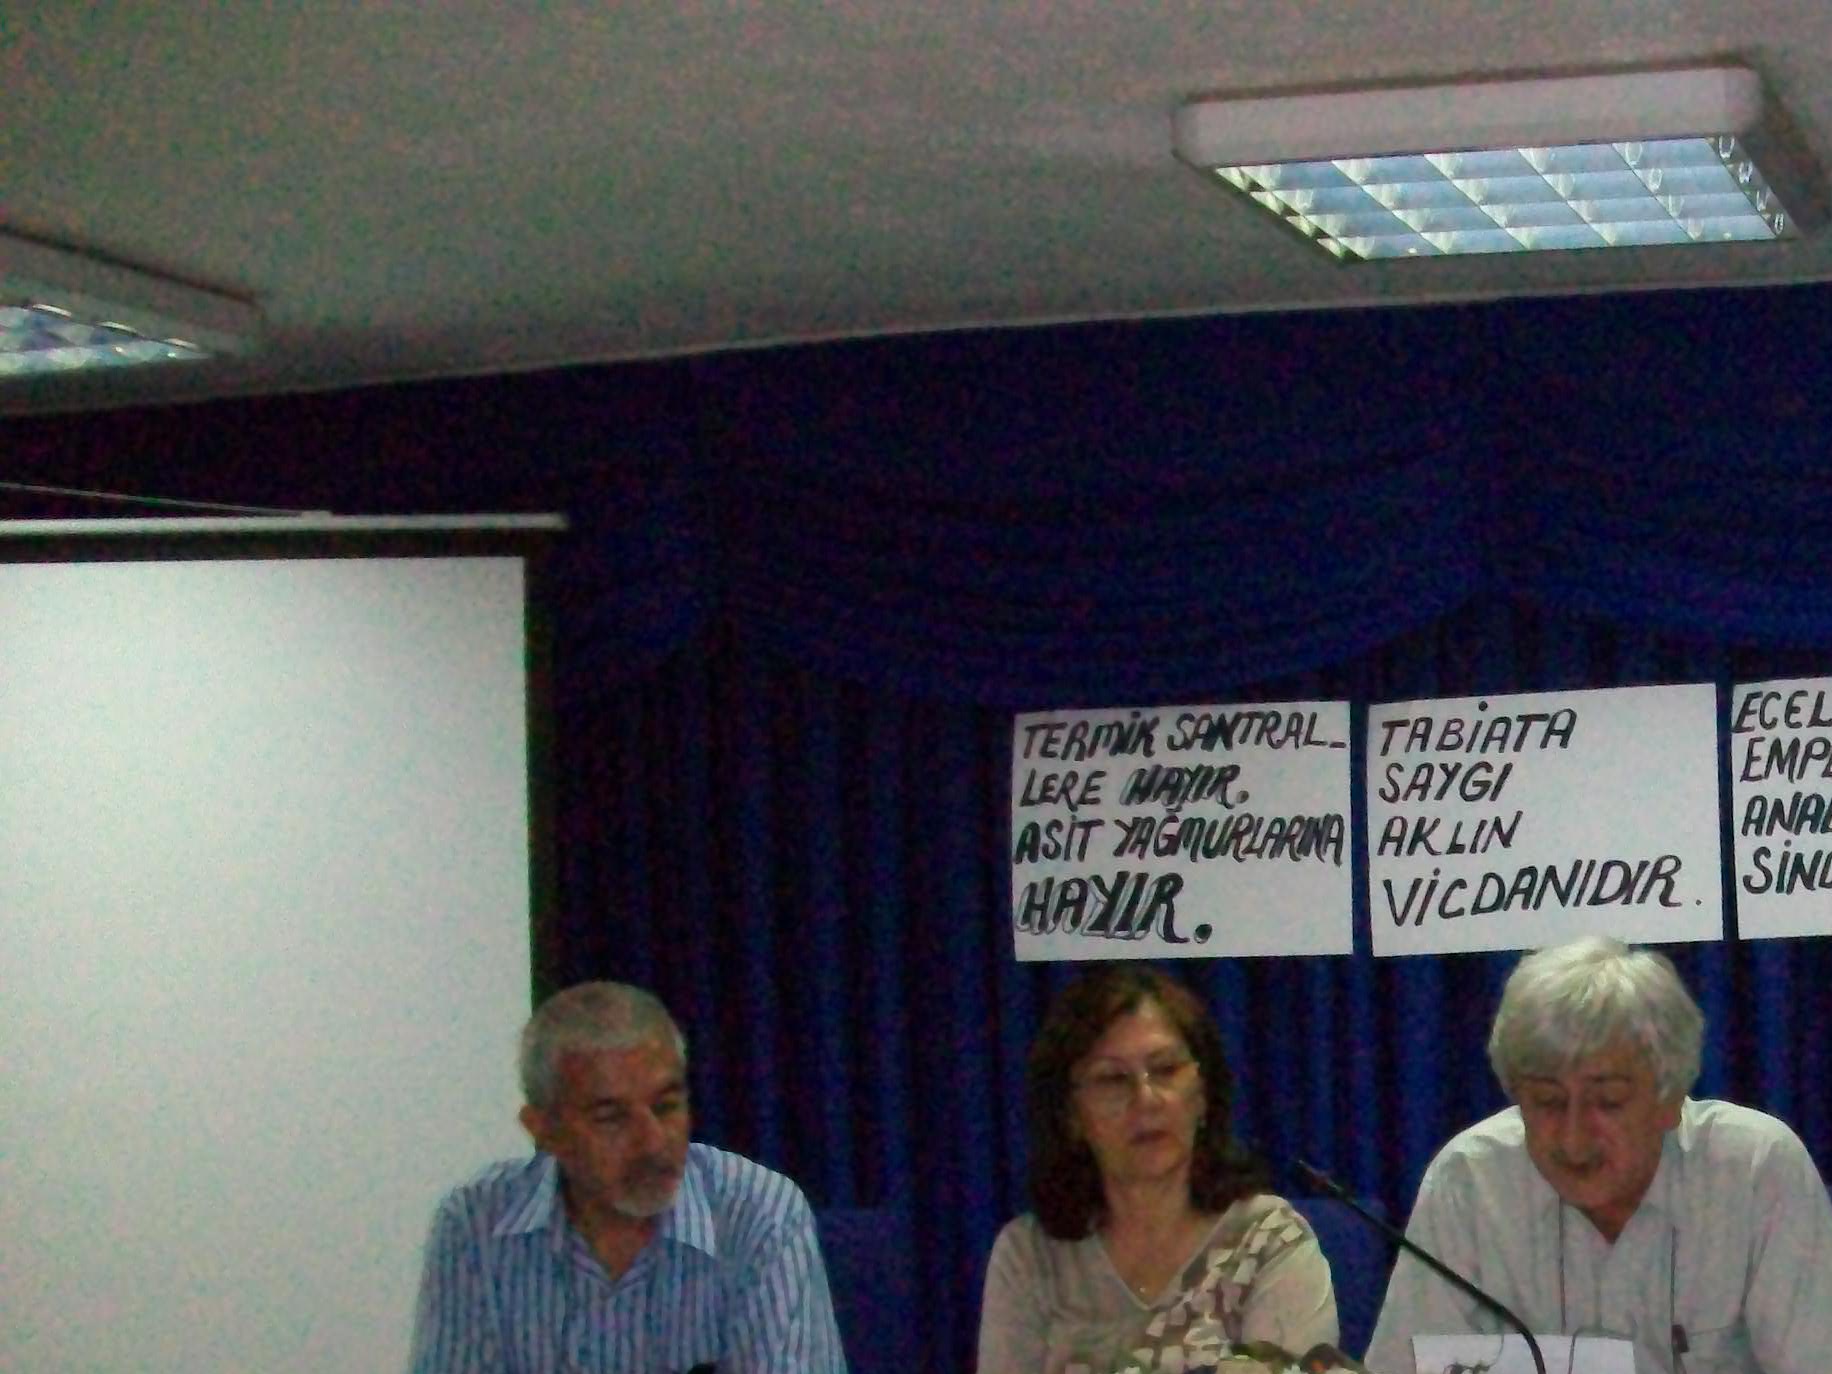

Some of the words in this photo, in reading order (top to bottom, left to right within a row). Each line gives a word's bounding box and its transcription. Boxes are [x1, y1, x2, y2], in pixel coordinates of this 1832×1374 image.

[1024, 712, 1160, 761] TERMİK
[1380, 701, 1577, 756] TABİATA
[1020, 768, 1106, 811] LERE
[1120, 764, 1249, 809] HAYIR.
[1379, 762, 1513, 802] SAYGI
[1013, 815, 1105, 864] ASİT
[1377, 811, 1523, 856] AKLIN
[1016, 871, 1213, 943] HAYIR.
[1383, 854, 1702, 926] VİCDANIDIR.
